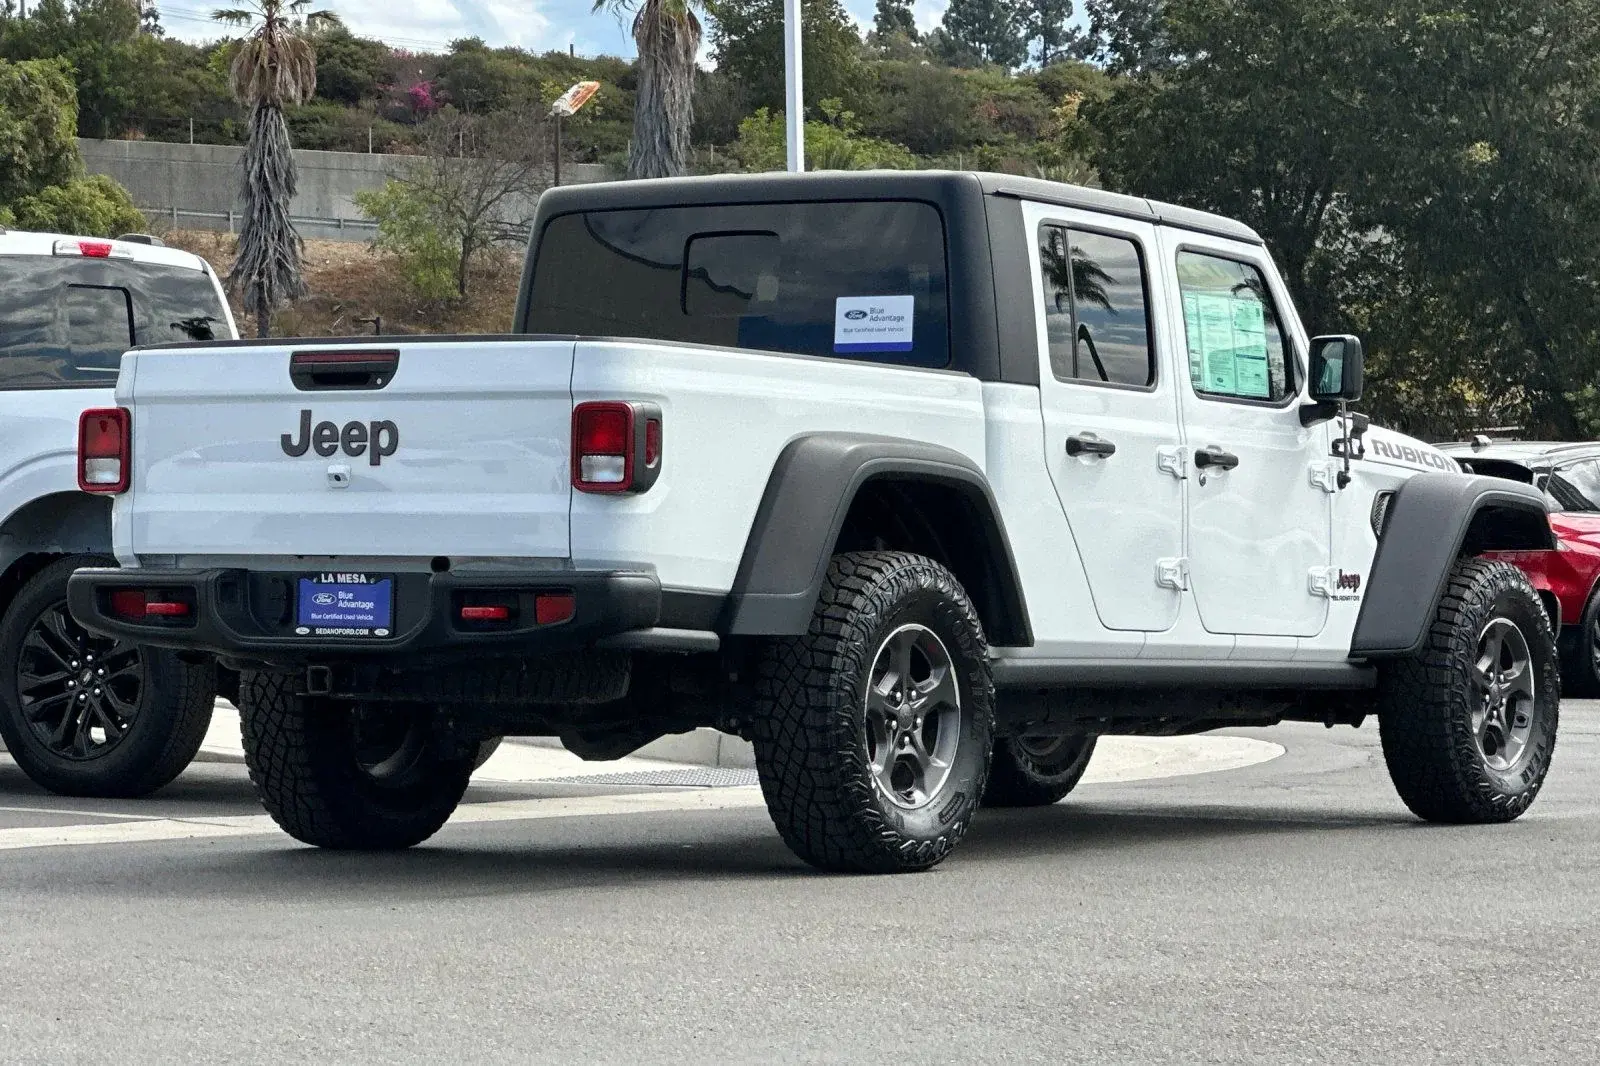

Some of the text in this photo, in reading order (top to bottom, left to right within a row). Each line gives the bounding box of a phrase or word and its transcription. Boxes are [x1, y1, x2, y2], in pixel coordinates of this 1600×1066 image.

[280, 409, 400, 466] Jeep
[1370, 439, 1457, 472] RUBICON
[321, 574, 367, 583] LA MESA
[1336, 568, 1360, 592] Jeep
[338, 600, 374, 610] Advantage
